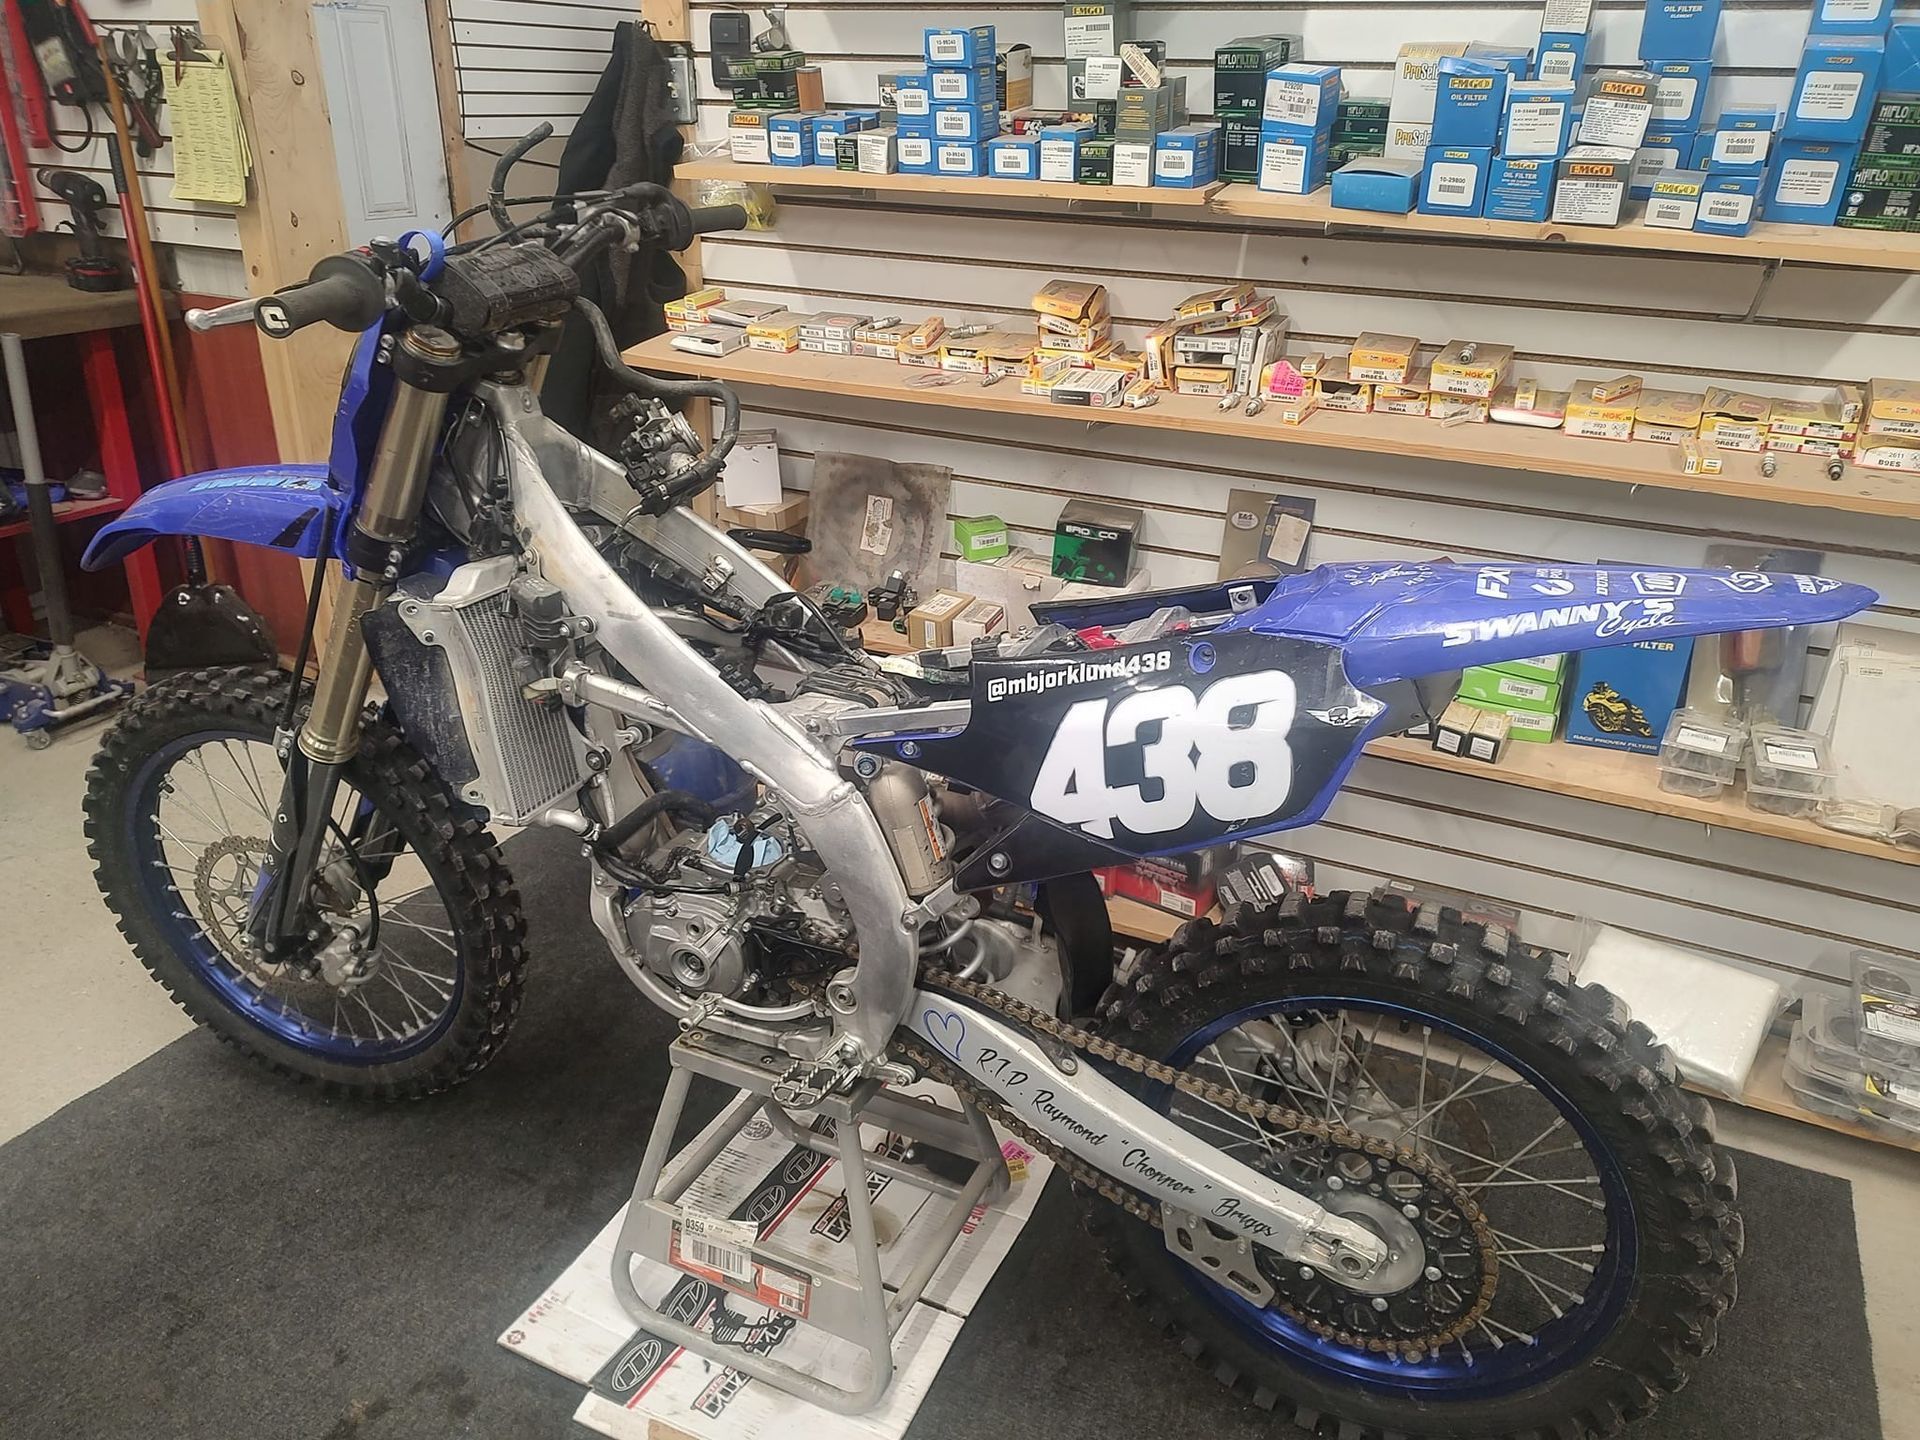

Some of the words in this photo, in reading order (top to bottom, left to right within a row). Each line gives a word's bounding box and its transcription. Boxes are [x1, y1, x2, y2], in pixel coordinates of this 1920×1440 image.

[1663, 5, 1676, 13] OIL
[1678, 5, 1703, 13] FILTER
[1450, 78, 1492, 88] EMGO
[1602, 81, 1647, 97] EMGO
[1450, 93, 1463, 101] OIL
[1463, 93, 1488, 101] FILTER
[1517, 171, 1538, 180] FILTER
[1570, 164, 1615, 177] EMGO
[1655, 183, 1700, 196] EMGO
[1602, 412, 1624, 420] NGK
[1878, 459, 1902, 468] B9ES
[1442, 598, 1676, 648] SWANNY'S
[1596, 612, 1685, 638] Cycle
[1633, 641, 1675, 651] FILTER
[987, 650, 1172, 702] @mbjorklund438
[1030, 669, 1297, 839] 438
[1031, 1089, 1108, 1146] Raymond
[1211, 1198, 1279, 1237] Briggs
